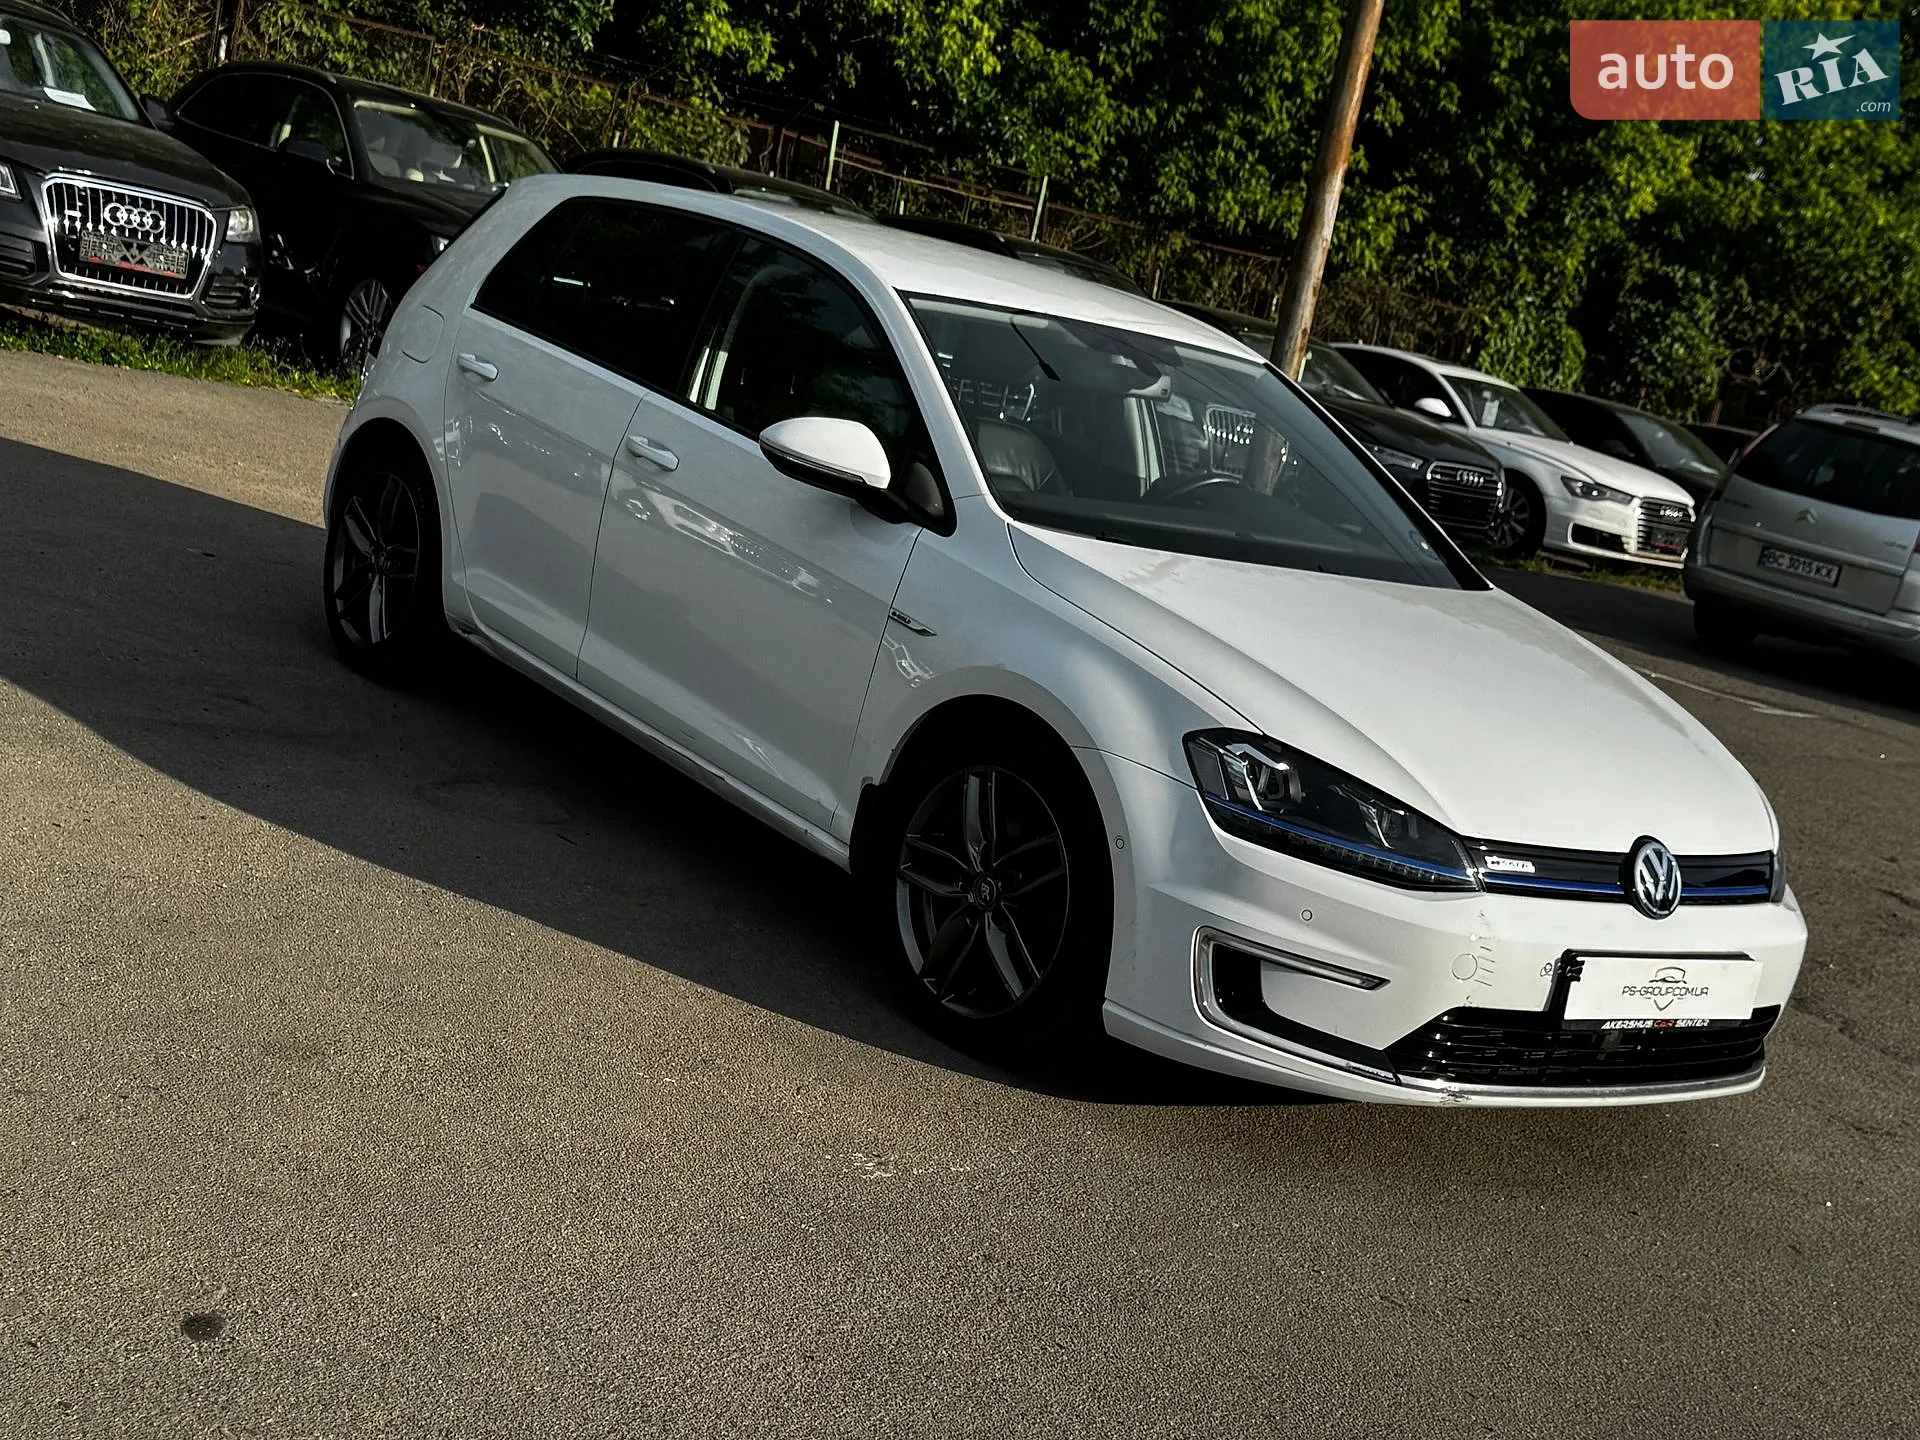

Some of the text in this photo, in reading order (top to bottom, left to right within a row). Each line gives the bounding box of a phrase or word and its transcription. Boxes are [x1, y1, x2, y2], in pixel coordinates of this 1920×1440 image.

[1601, 1019, 1710, 1030] AKERSHUS CAR SENTER
